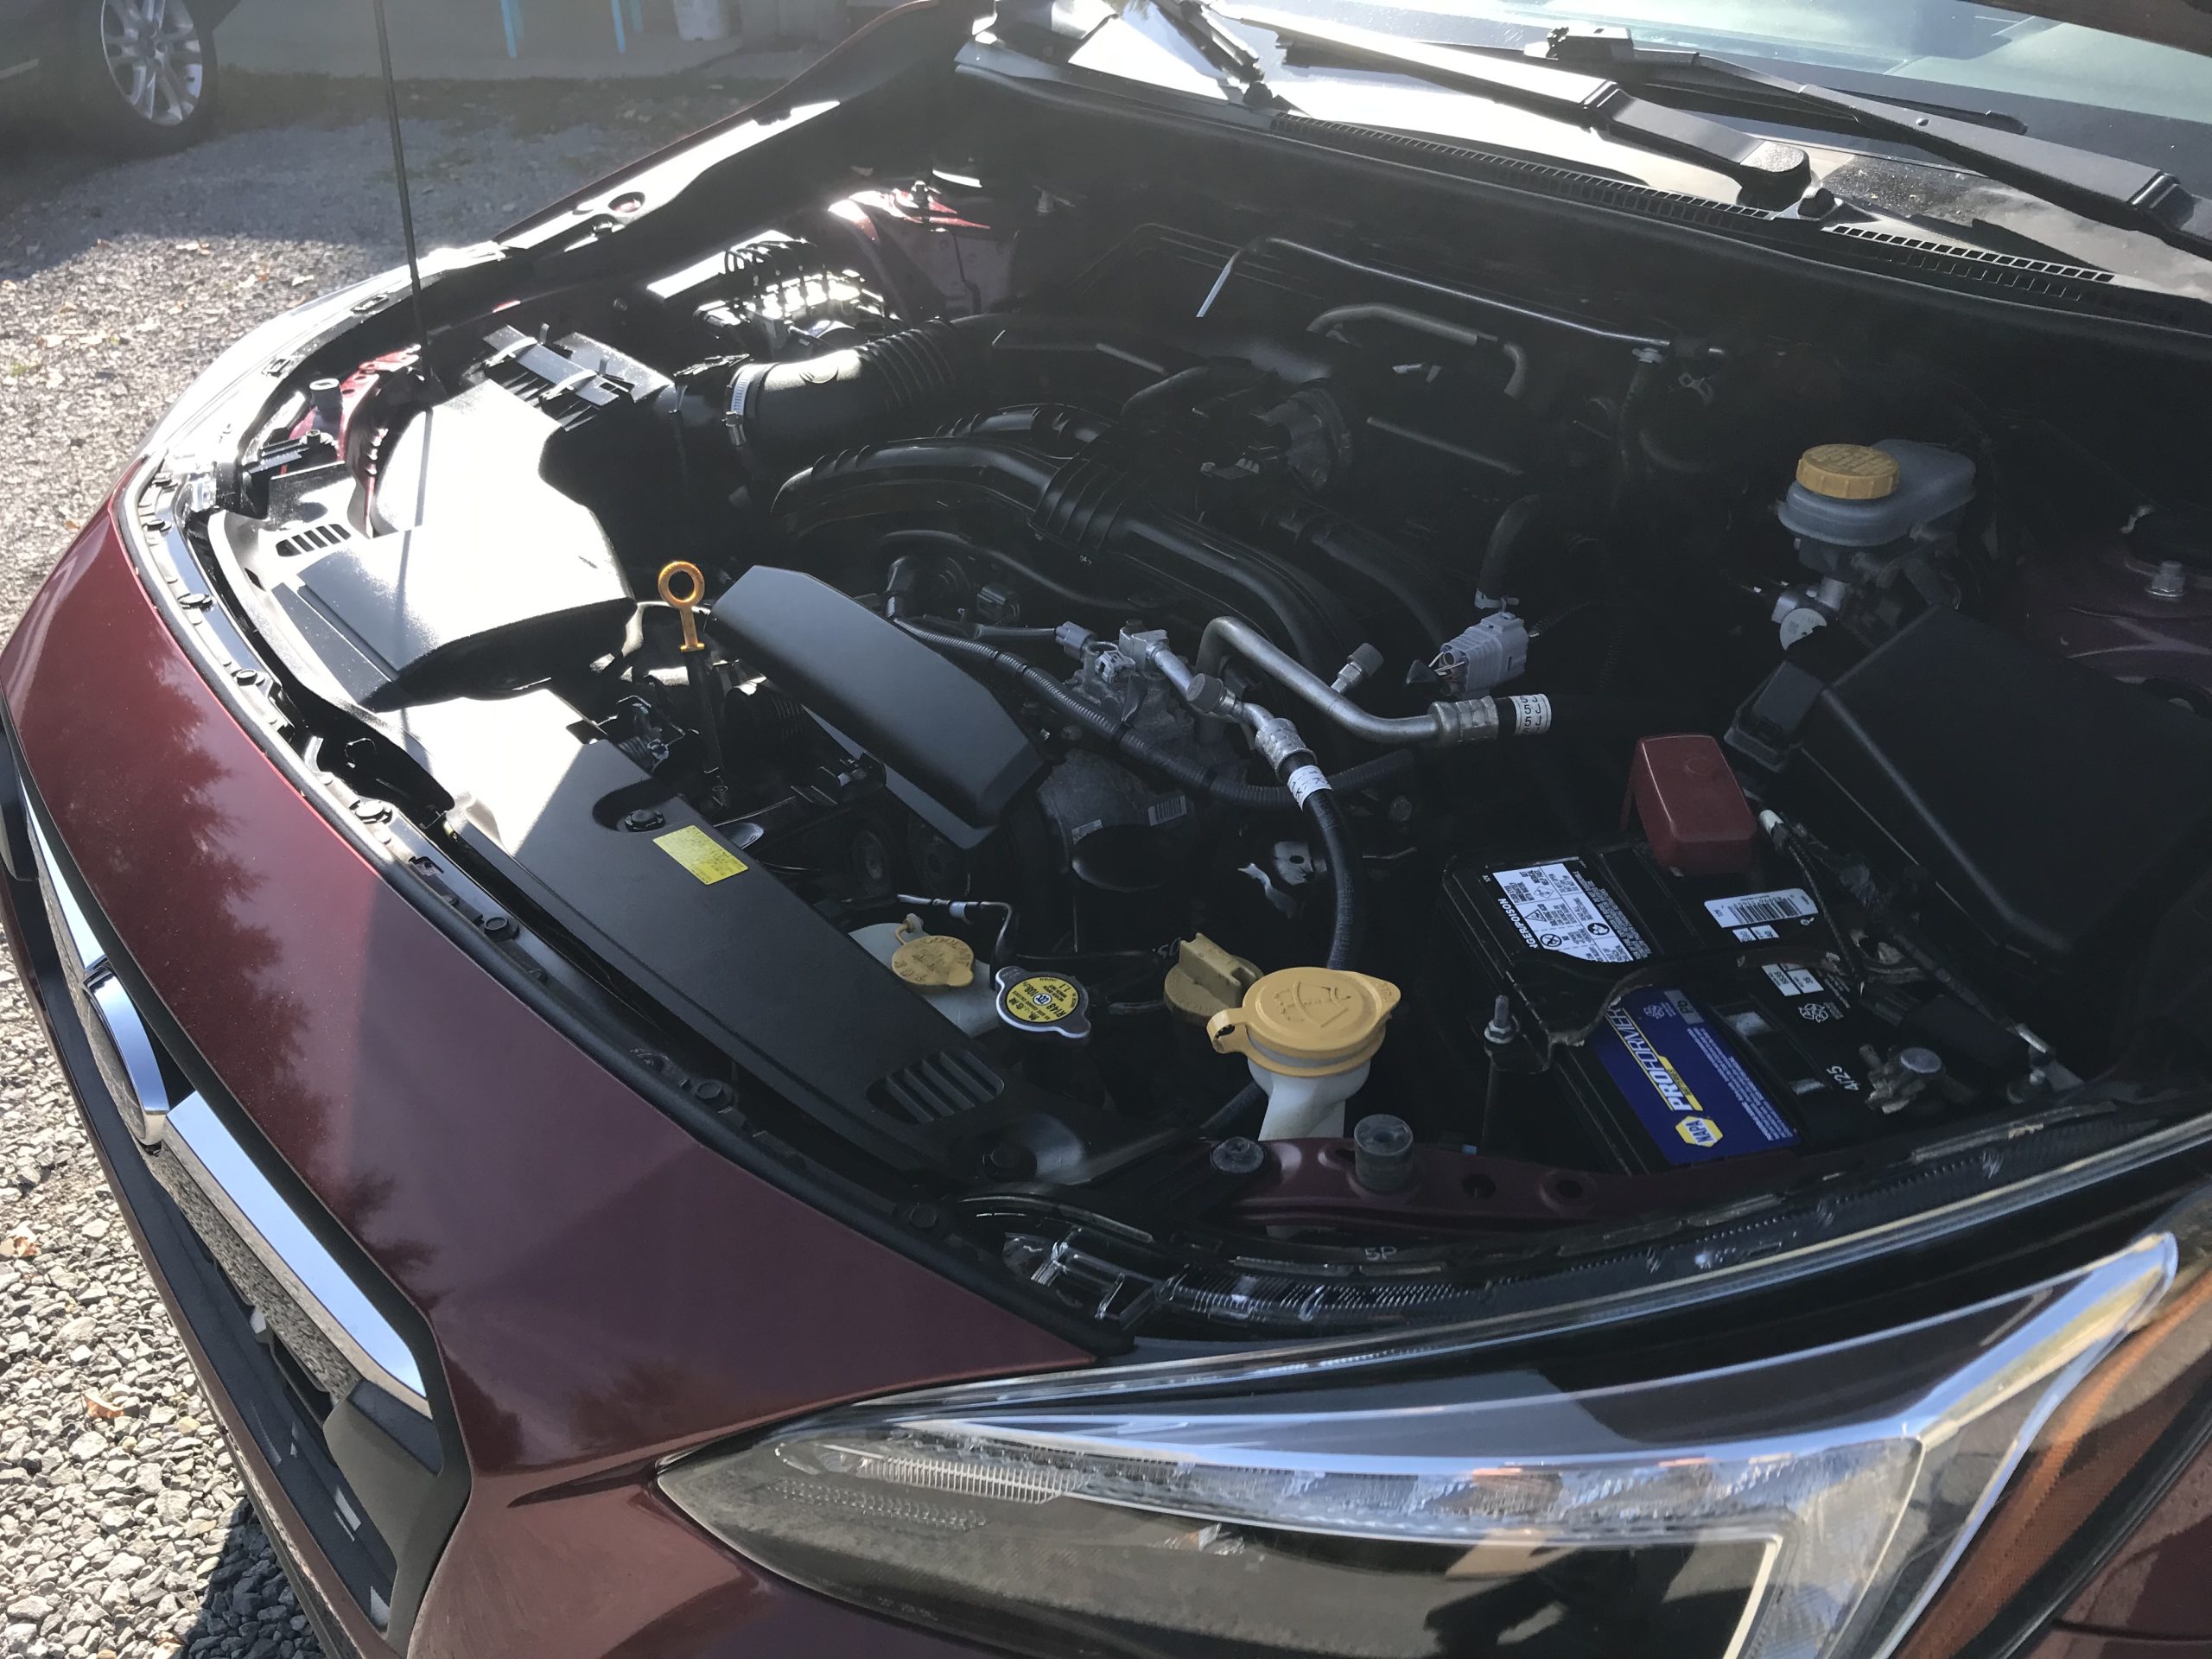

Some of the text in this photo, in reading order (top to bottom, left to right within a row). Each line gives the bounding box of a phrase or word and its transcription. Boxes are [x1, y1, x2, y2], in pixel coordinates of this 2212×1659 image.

[1677, 1000, 1693, 1015] Pb
[1607, 1007, 1694, 1111] PROFORMER
[1826, 1065, 1859, 1090] 4/25
[1685, 1118, 1715, 1145] NAPA
